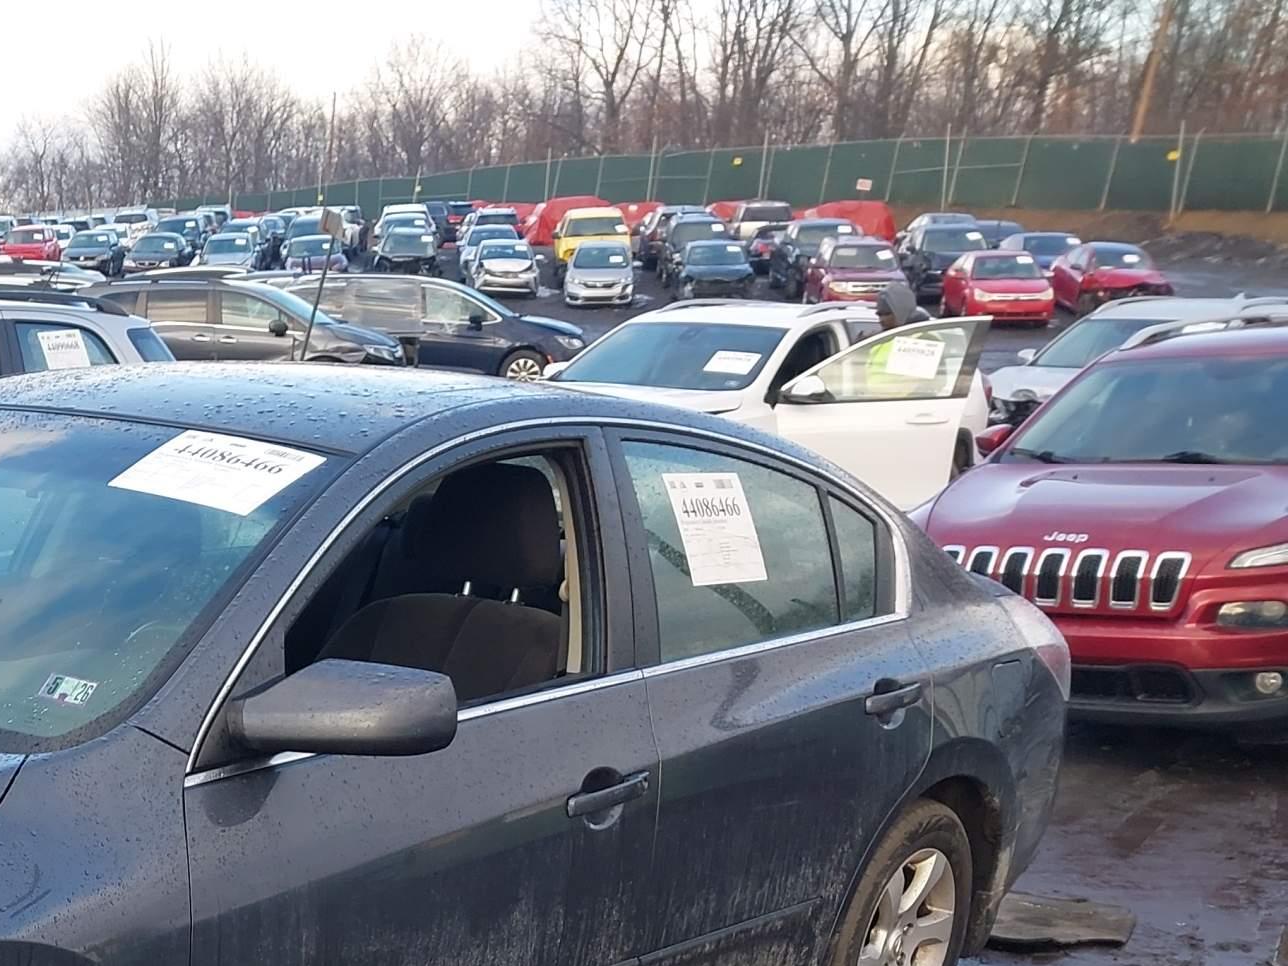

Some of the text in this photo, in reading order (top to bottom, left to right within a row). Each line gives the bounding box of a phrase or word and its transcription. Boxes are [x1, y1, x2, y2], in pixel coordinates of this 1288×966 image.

[174, 444, 288, 474] 44086466
[681, 496, 741, 518] 44086466
[1043, 531, 1089, 543] Jeep
